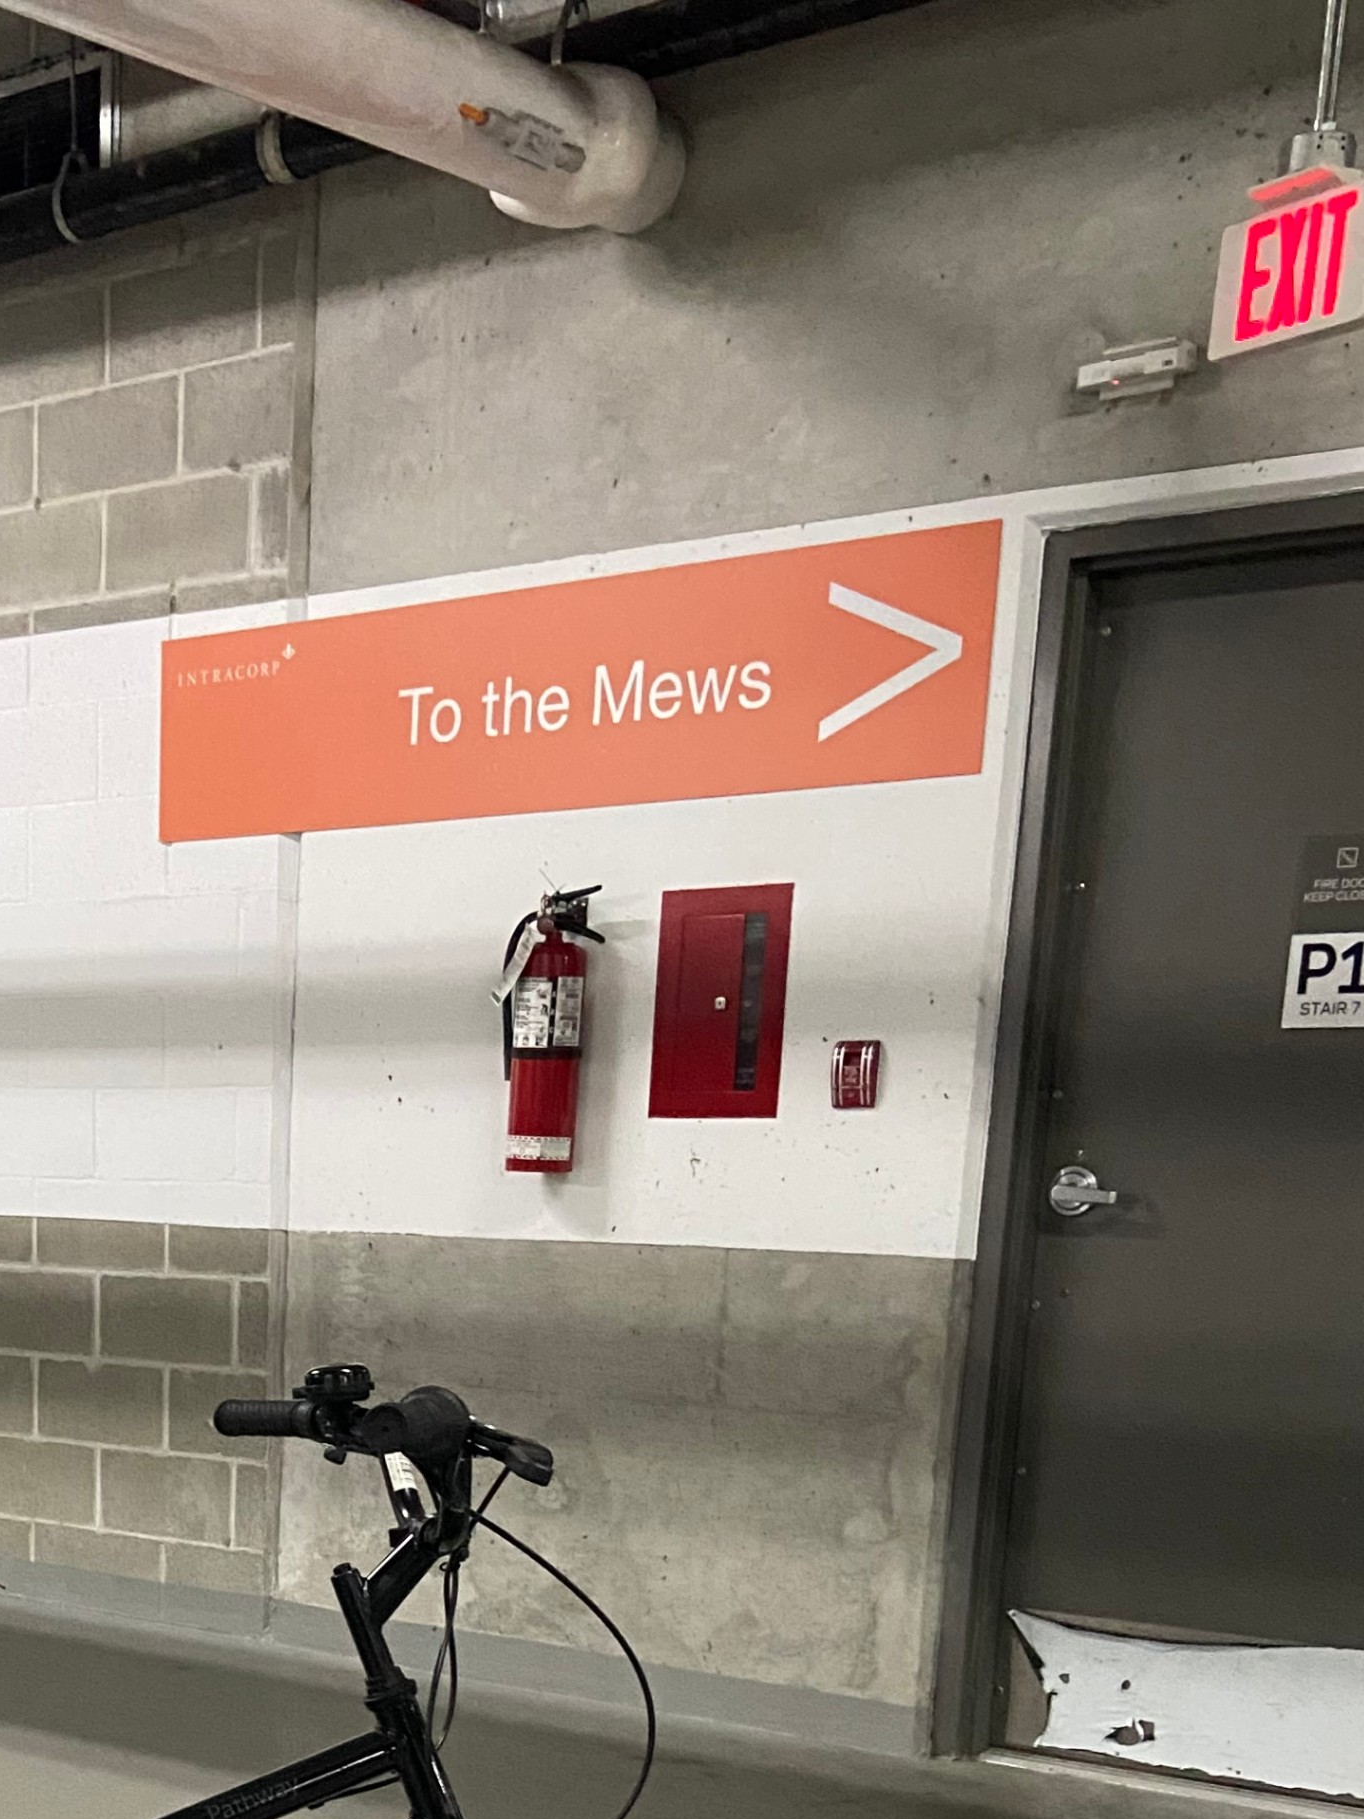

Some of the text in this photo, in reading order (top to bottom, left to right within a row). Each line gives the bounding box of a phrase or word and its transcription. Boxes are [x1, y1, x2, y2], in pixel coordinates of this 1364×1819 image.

[1235, 190, 1358, 341] EXIT
[177, 660, 281, 688] INTRACORP
[398, 660, 772, 745] To the Mews
[1303, 891, 1334, 902] KEEP
[1313, 879, 1339, 889] FIRE
[1297, 941, 1364, 994] P1
[1299, 1001, 1361, 1016] STAIR 7
